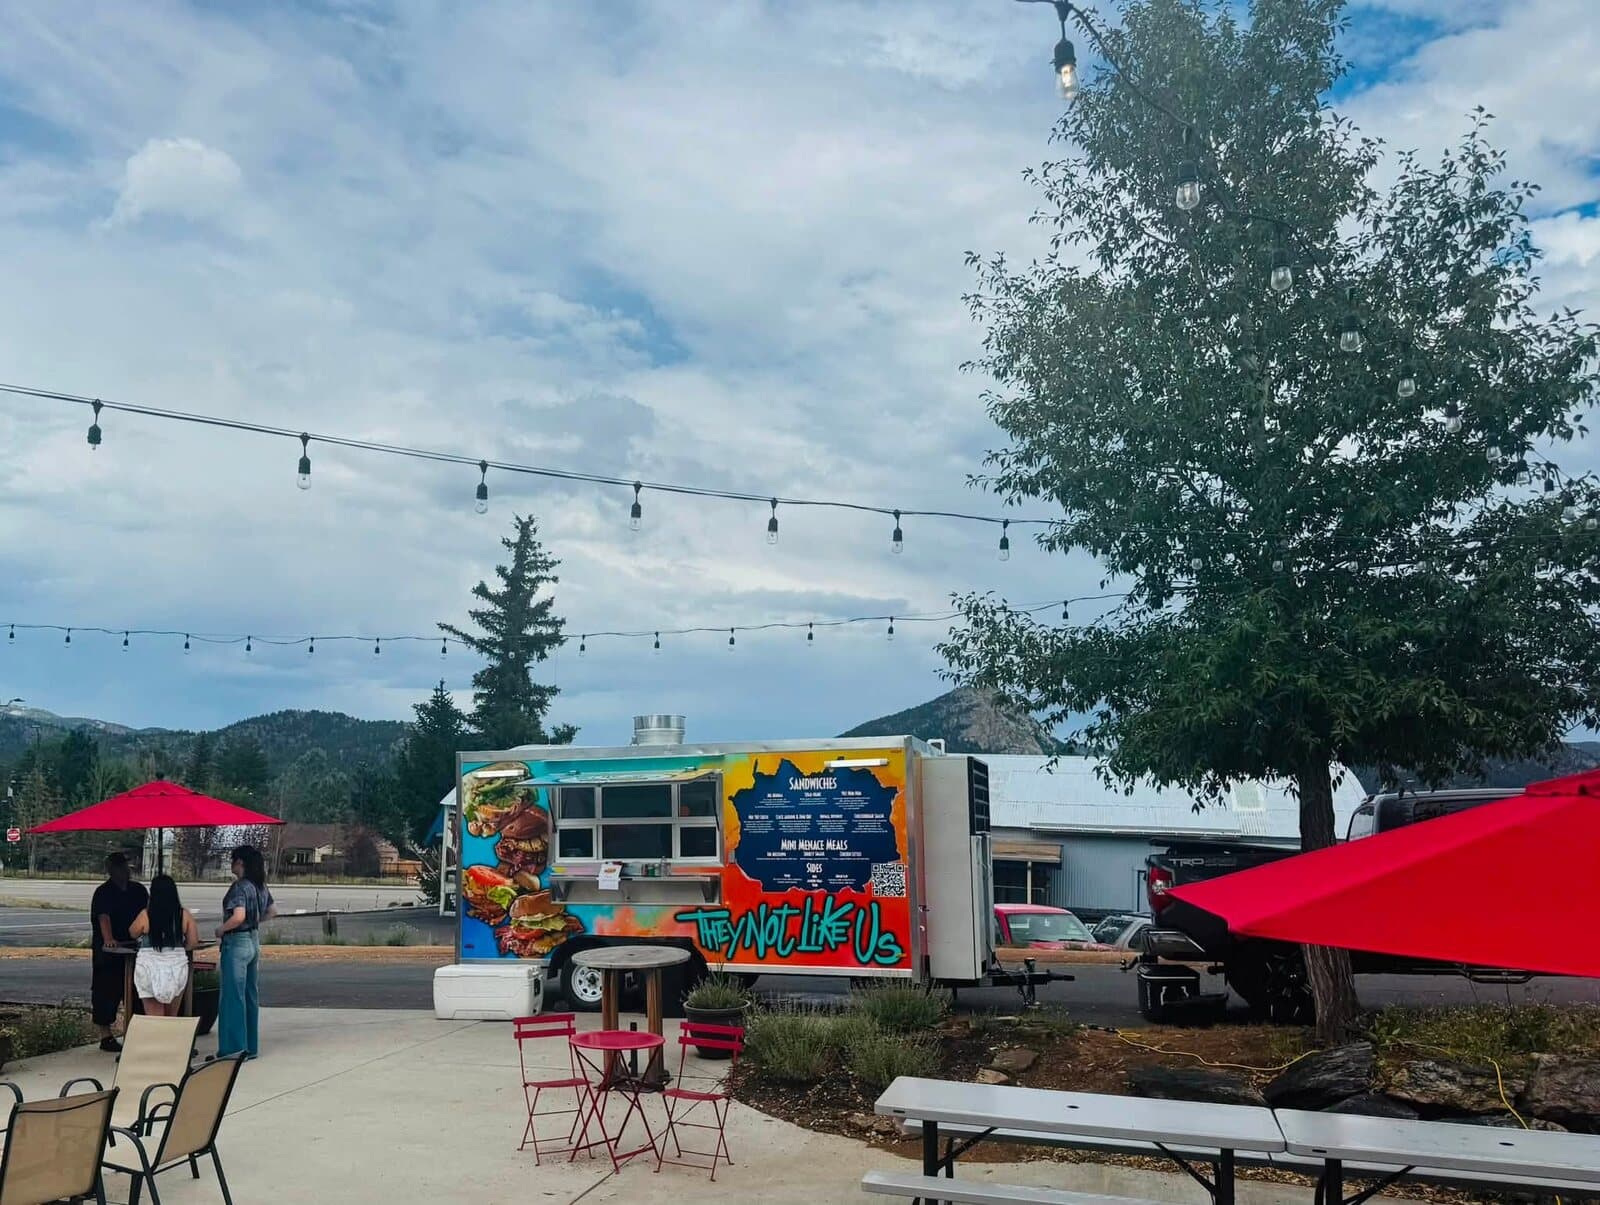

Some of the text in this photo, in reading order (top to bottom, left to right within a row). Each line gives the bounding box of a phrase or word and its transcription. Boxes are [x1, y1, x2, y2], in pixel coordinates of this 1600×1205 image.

[789, 776, 837, 790] SANDWICHES
[781, 839, 848, 851] MINI MENACE MEALS
[806, 862, 822, 873] SIDES
